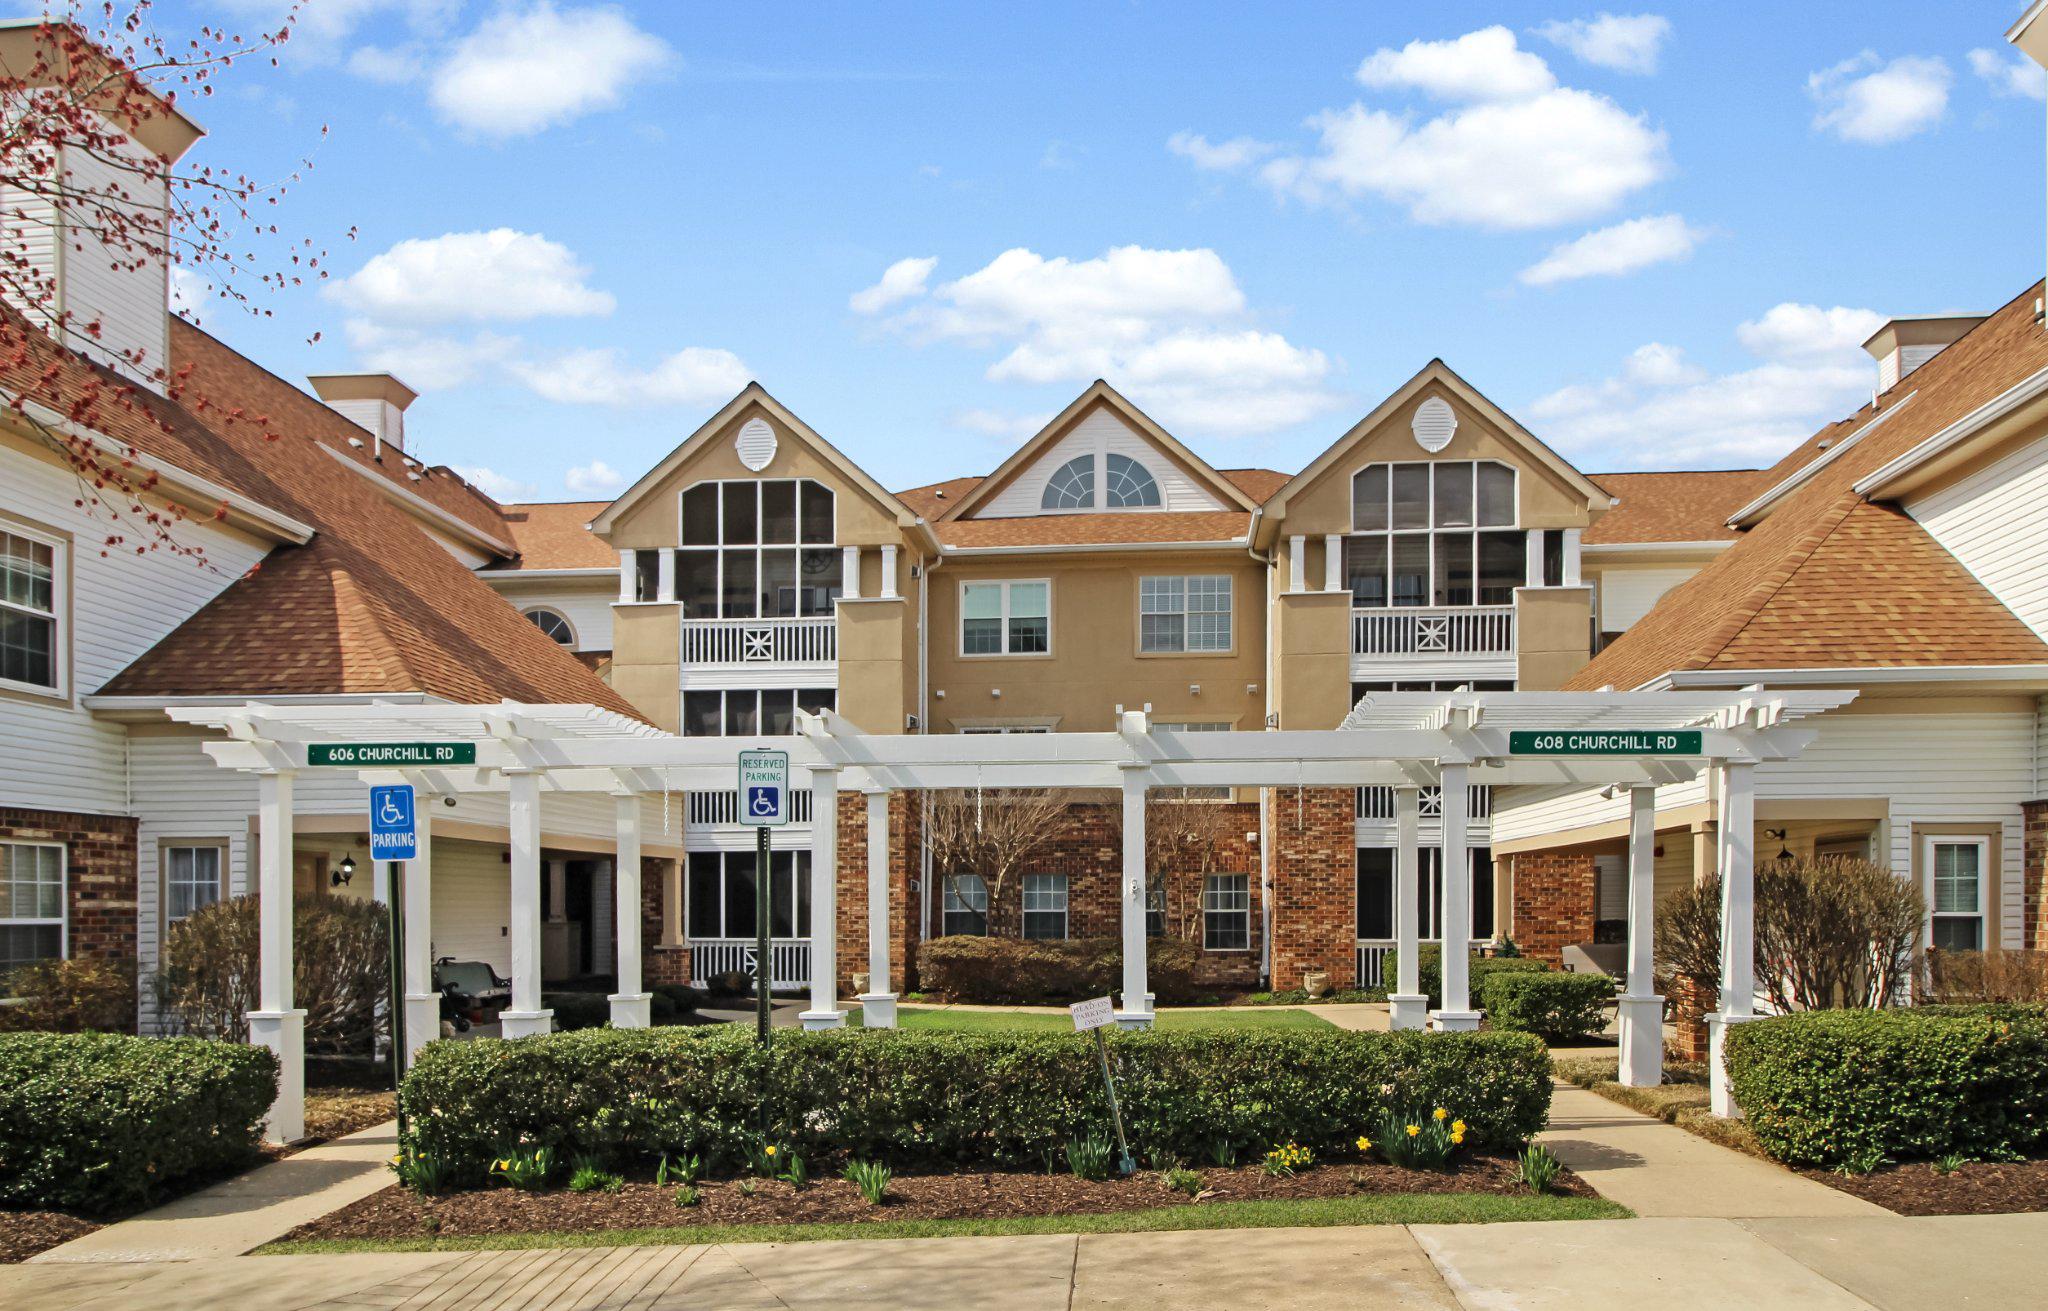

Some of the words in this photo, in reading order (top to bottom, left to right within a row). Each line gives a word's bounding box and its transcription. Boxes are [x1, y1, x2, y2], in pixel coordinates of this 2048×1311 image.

[1534, 736, 1564, 749] 608
[1568, 736, 1652, 749] CHURCHILL
[1657, 736, 1677, 749] RD
[329, 748, 355, 761] 606
[358, 747, 432, 760] CHURCHILL
[436, 747, 454, 760] RD
[742, 759, 785, 769] RESERVED
[745, 772, 781, 781] PARKING
[373, 832, 415, 848] PARKING
